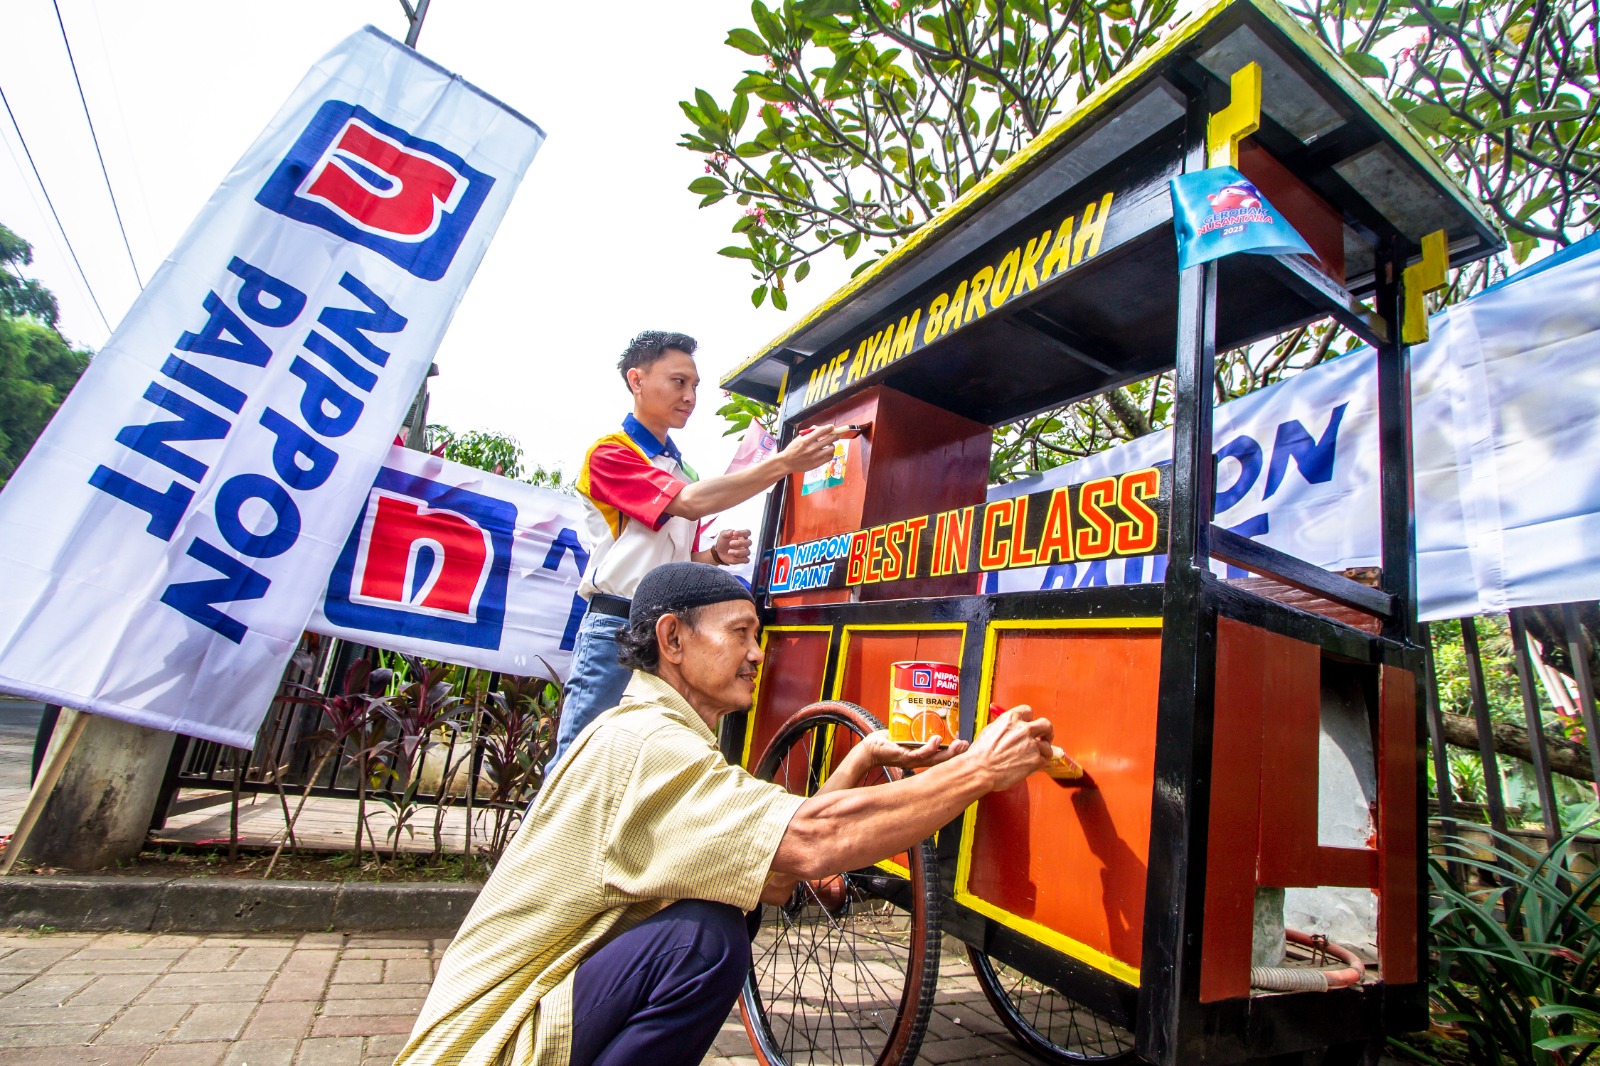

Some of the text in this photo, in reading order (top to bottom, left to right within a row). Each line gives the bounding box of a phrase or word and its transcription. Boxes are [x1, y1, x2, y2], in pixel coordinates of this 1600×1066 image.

[1197, 214, 1273, 237] NUSANTARA
[1204, 207, 1268, 224] GEROBAK
[1223, 225, 1244, 236] 2025
[803, 192, 1114, 408] MIE AYAM BAROKAH
[88, 255, 308, 542] PAINT
[160, 271, 408, 645] NIPPON
[846, 515, 928, 586] BEST
[930, 506, 975, 577] IN
[979, 467, 1161, 571] CLASS
[795, 534, 851, 565] NIPPON
[792, 561, 835, 589] PAINT
[937, 679, 957, 690] PAINT
[925, 698, 952, 707] BRAND
